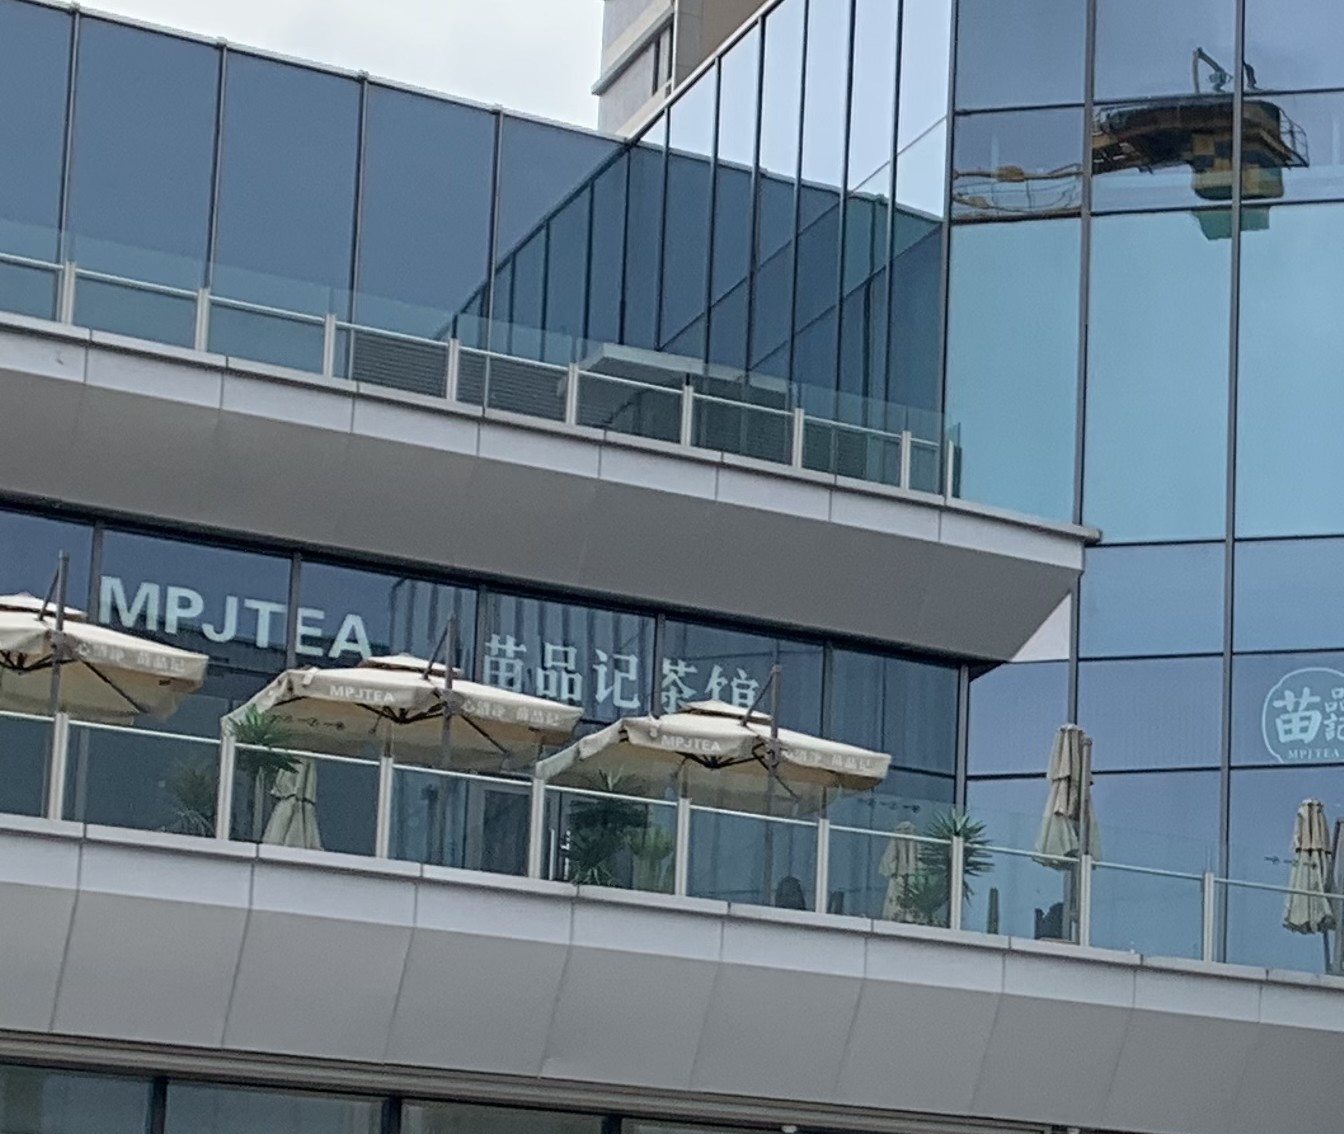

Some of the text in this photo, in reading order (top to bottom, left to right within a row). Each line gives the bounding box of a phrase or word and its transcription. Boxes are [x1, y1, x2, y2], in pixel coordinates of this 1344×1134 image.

[99, 575, 373, 659] MPJTEA
[481, 634, 761, 713] 苗品记茶馆
[329, 684, 396, 703] MPJTEA
[660, 734, 722, 752] MPJTEA
[1288, 748, 1341, 760] MPJTEA
